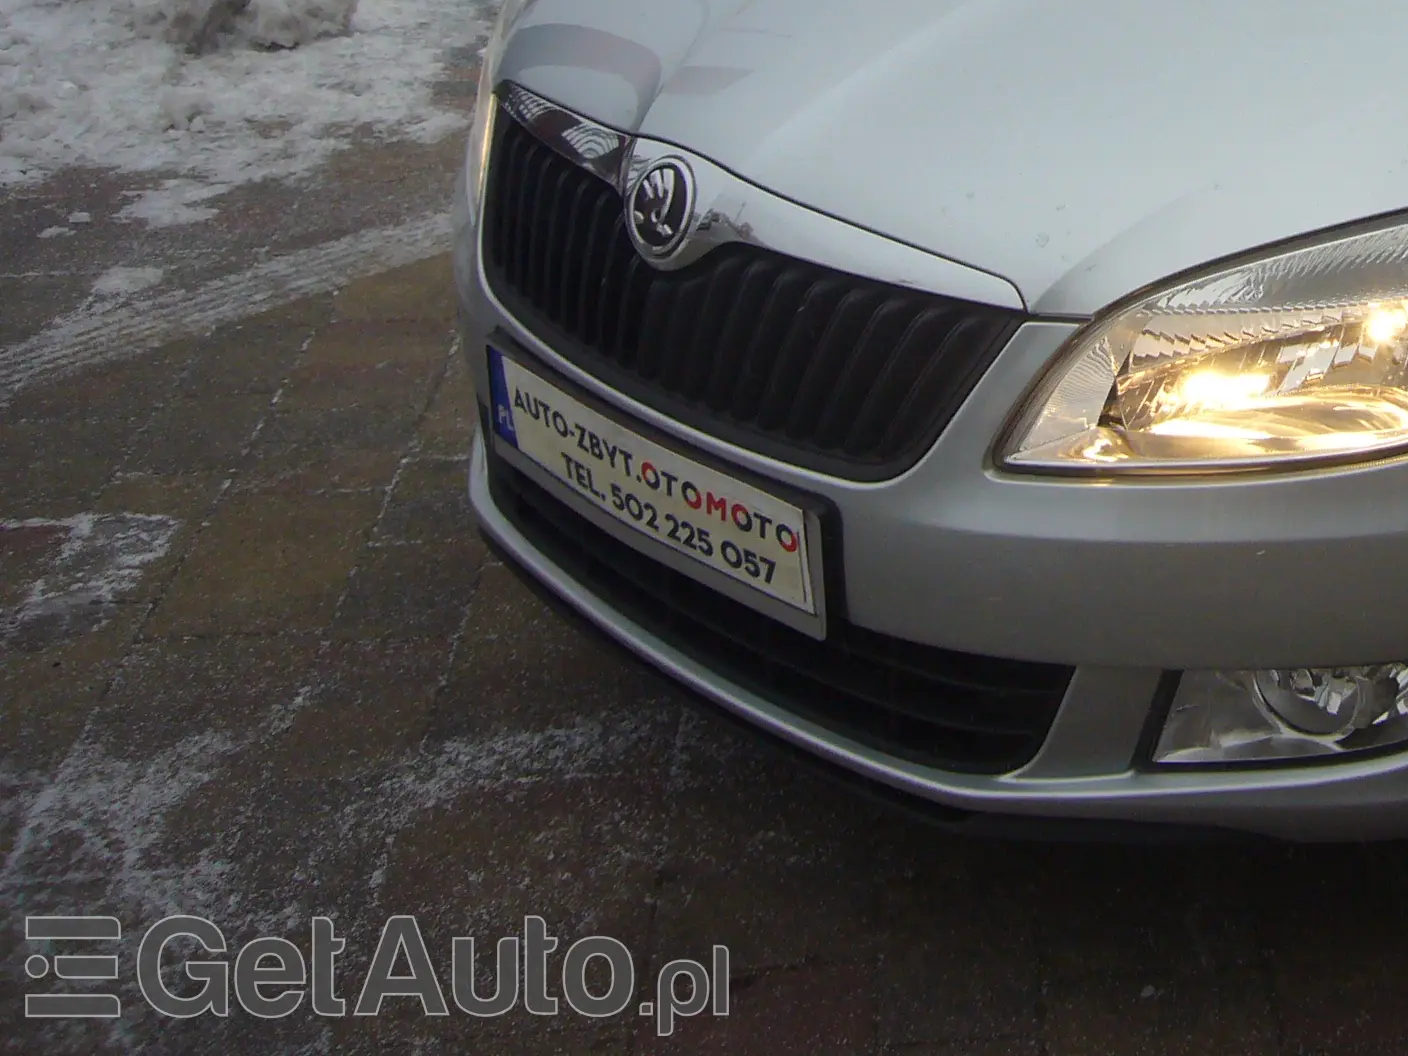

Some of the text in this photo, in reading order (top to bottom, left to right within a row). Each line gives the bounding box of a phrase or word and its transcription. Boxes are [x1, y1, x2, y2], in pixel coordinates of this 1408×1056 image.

[560, 451, 778, 585] TEL. 502 225 057
